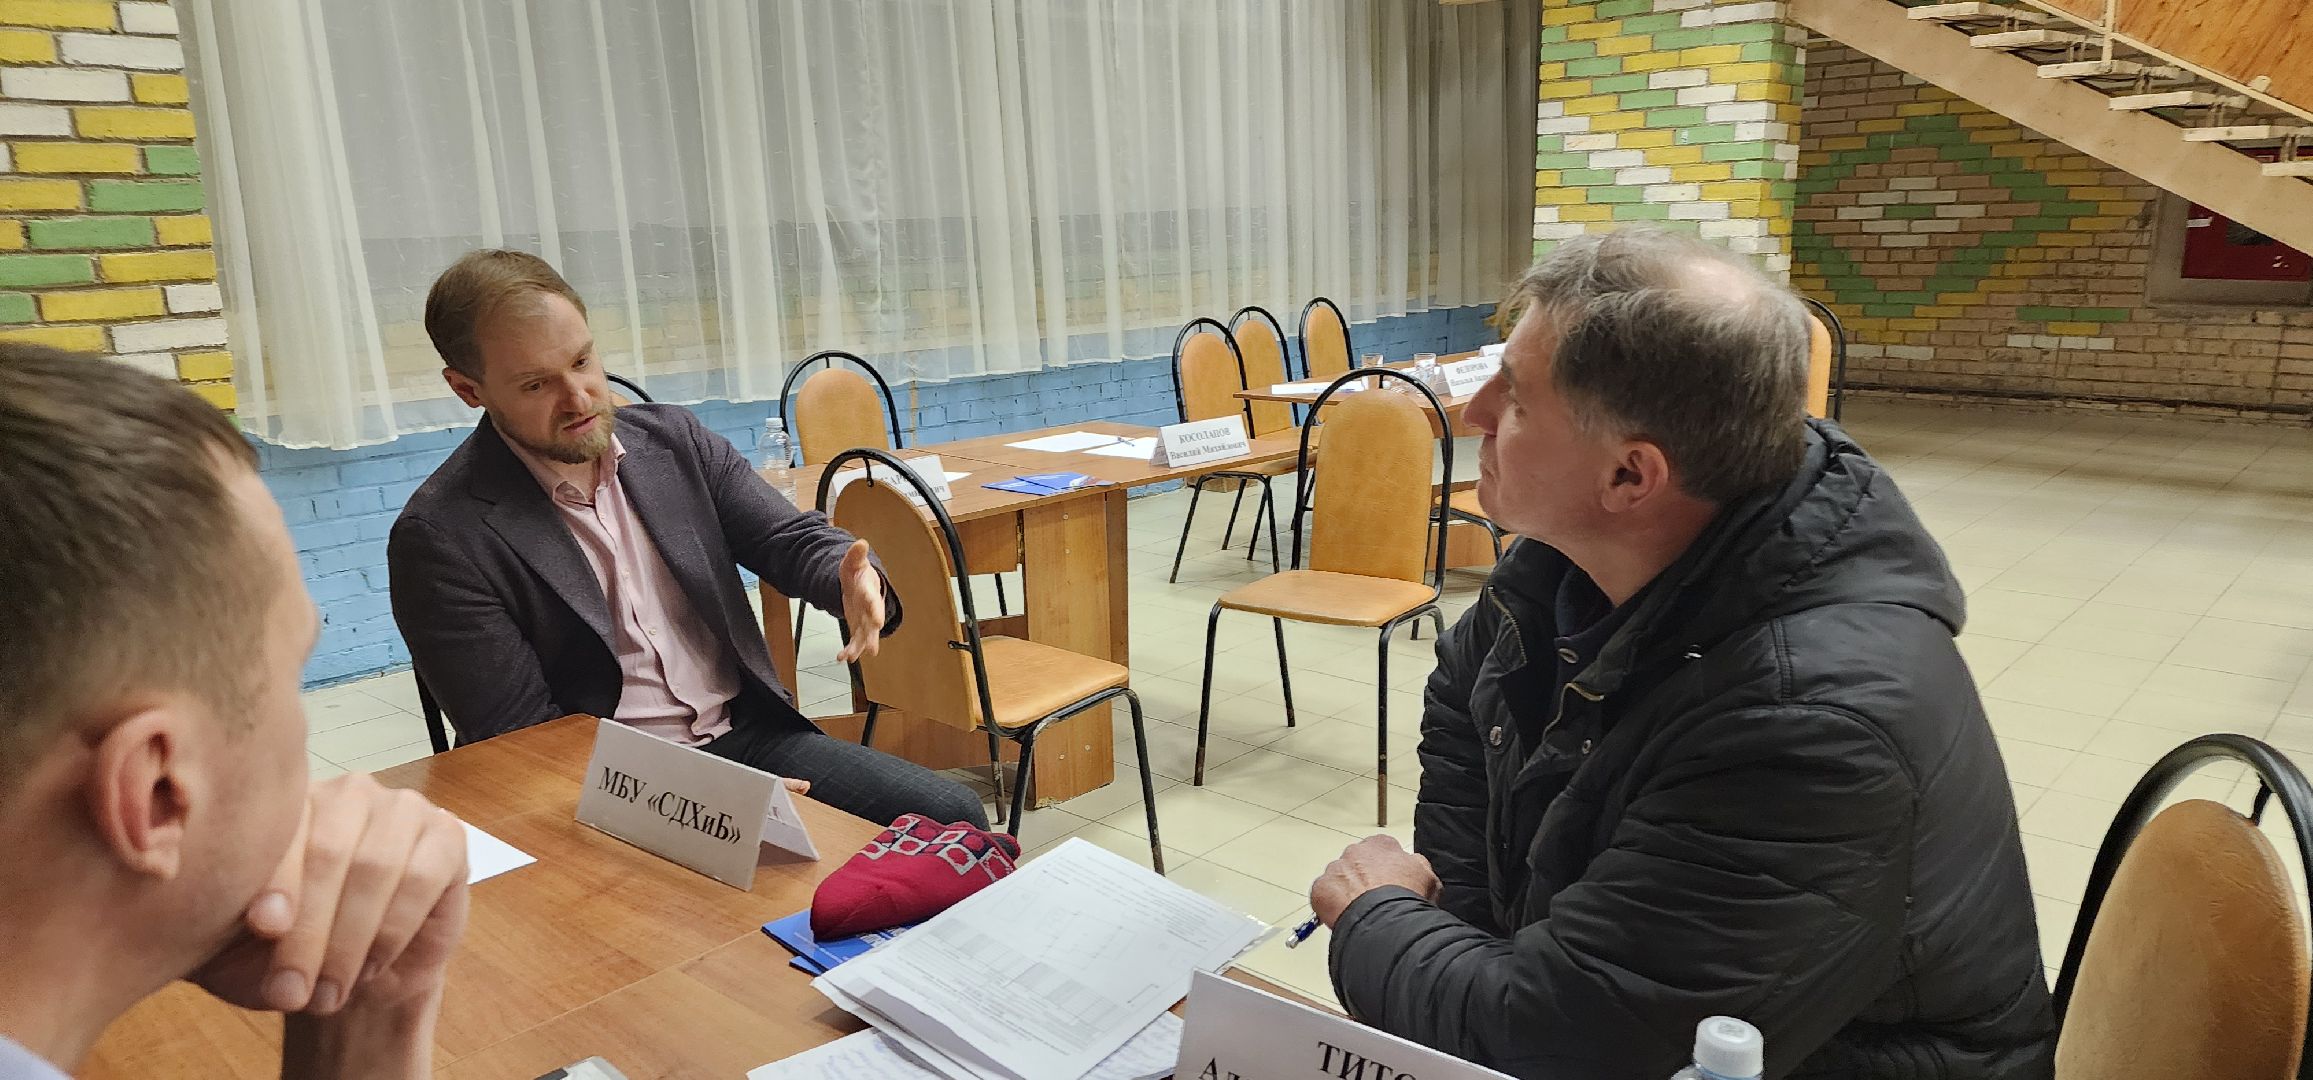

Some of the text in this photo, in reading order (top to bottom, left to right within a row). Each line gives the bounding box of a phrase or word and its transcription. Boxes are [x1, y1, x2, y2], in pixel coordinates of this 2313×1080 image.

[1178, 427, 1232, 444] КОСОЛАПОВ
[598, 766, 741, 844] МБУ «СДХиБ»
